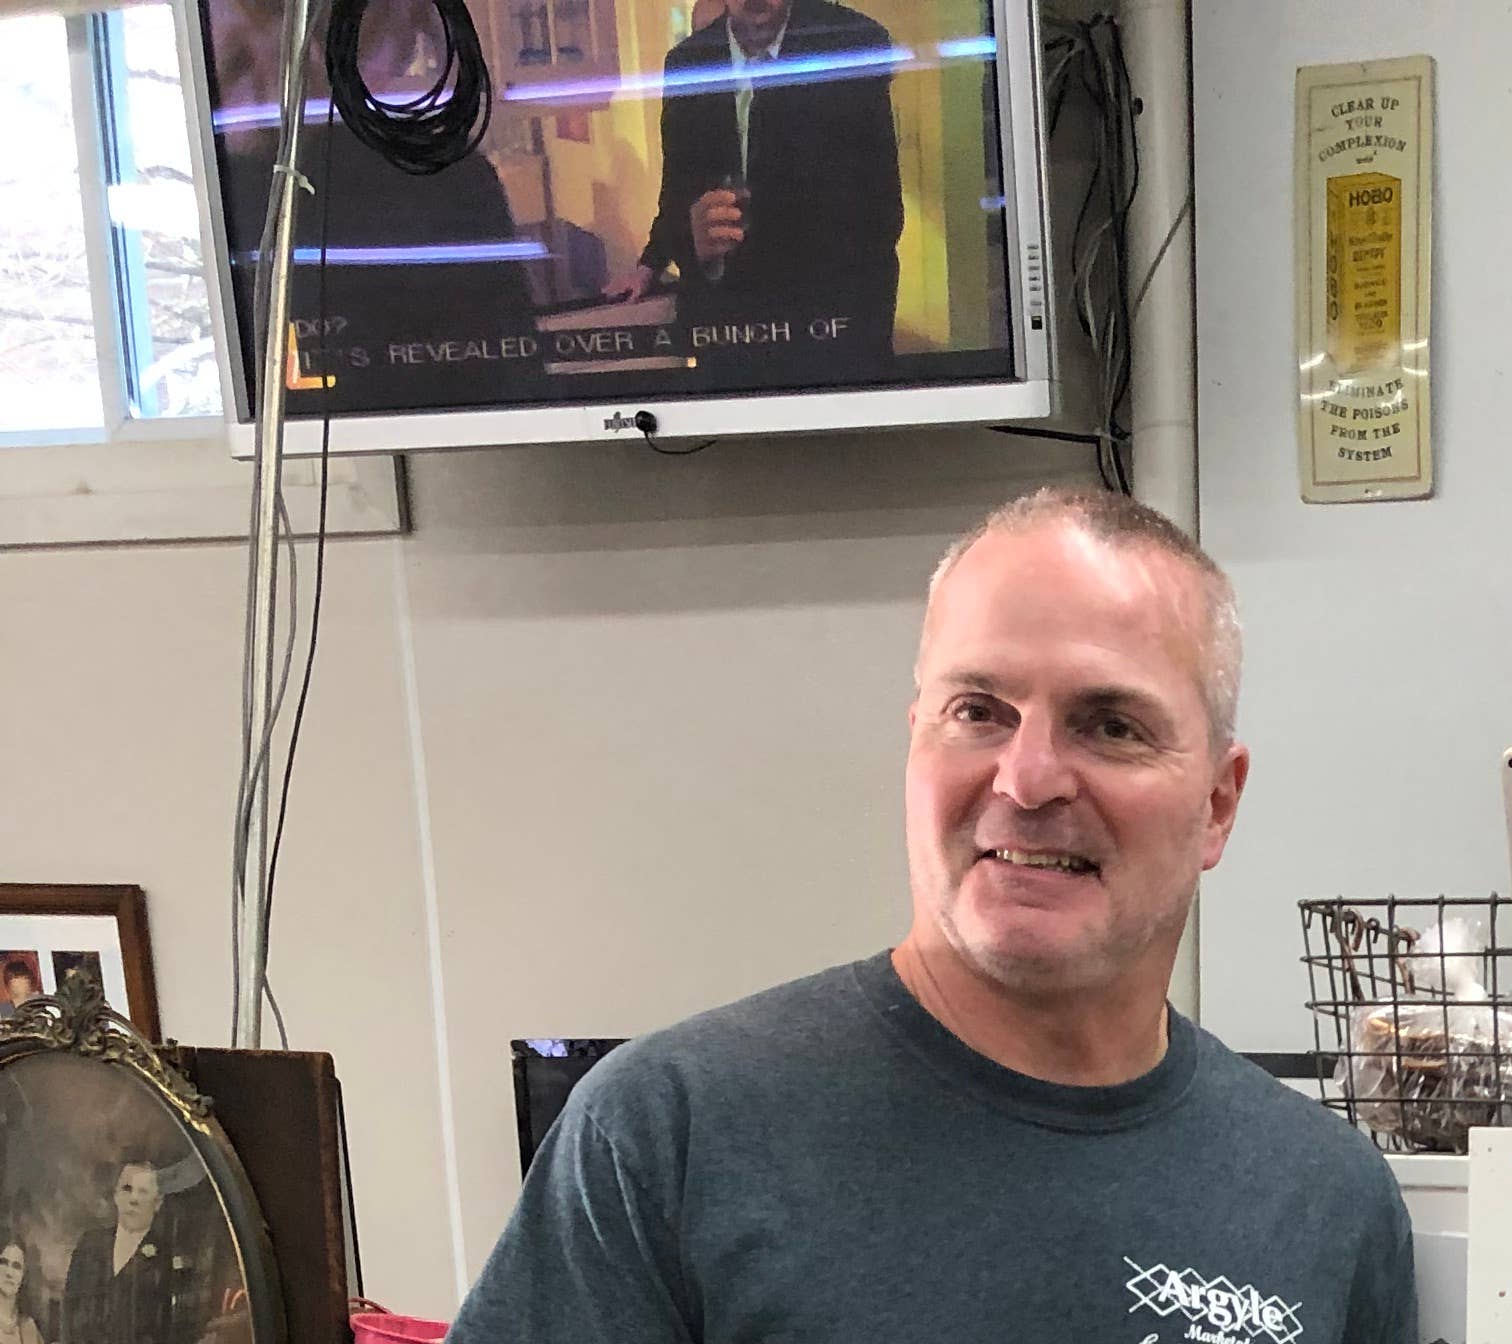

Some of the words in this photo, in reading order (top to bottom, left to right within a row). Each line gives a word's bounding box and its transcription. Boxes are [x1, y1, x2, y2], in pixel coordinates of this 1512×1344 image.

[1331, 98, 1375, 117] CLEAR
[1381, 98, 1399, 110] UP
[1346, 116, 1382, 129] YOUR
[1319, 135, 1406, 162] COMPLEXION
[1349, 187, 1393, 208] HOBO
[390, 337, 536, 363] REVEALED
[556, 329, 635, 355] OVER
[657, 329, 674, 349] A
[693, 320, 791, 344] BUNCH
[810, 316, 851, 340] OF
[1321, 400, 1347, 418] THE
[1330, 424, 1367, 440] FROM
[1373, 423, 1400, 439] THE
[1338, 446, 1392, 461] SYSTEM
[1158, 1270, 1284, 1332] Argyle
